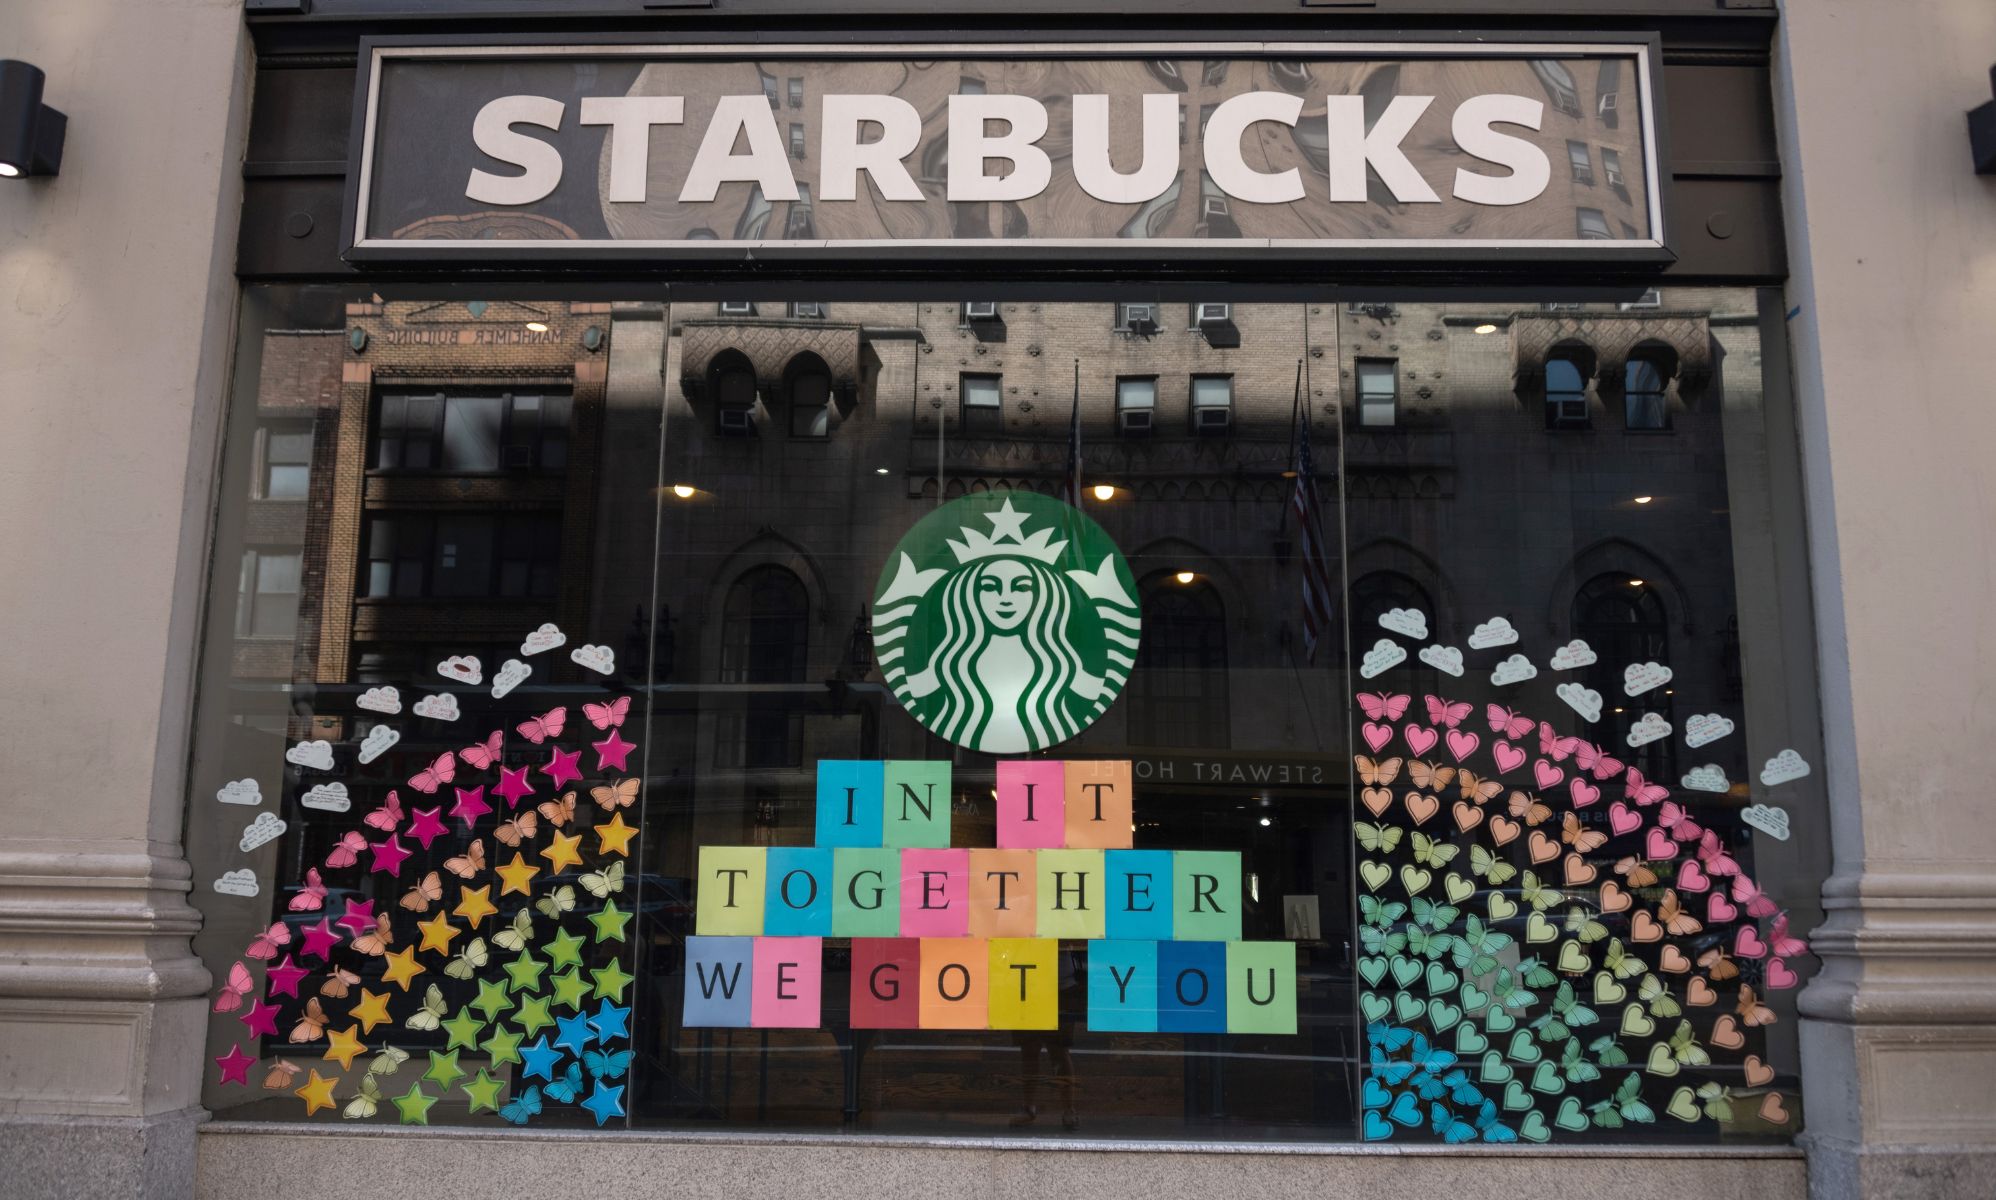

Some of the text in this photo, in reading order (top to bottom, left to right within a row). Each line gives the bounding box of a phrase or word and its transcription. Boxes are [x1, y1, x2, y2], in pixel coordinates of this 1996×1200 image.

[465, 91, 1550, 205] STARBUCKS
[843, 783, 1114, 825] IN IT
[715, 868, 1226, 914] TOGETHER
[696, 961, 1277, 1007] WE GOT YOU
